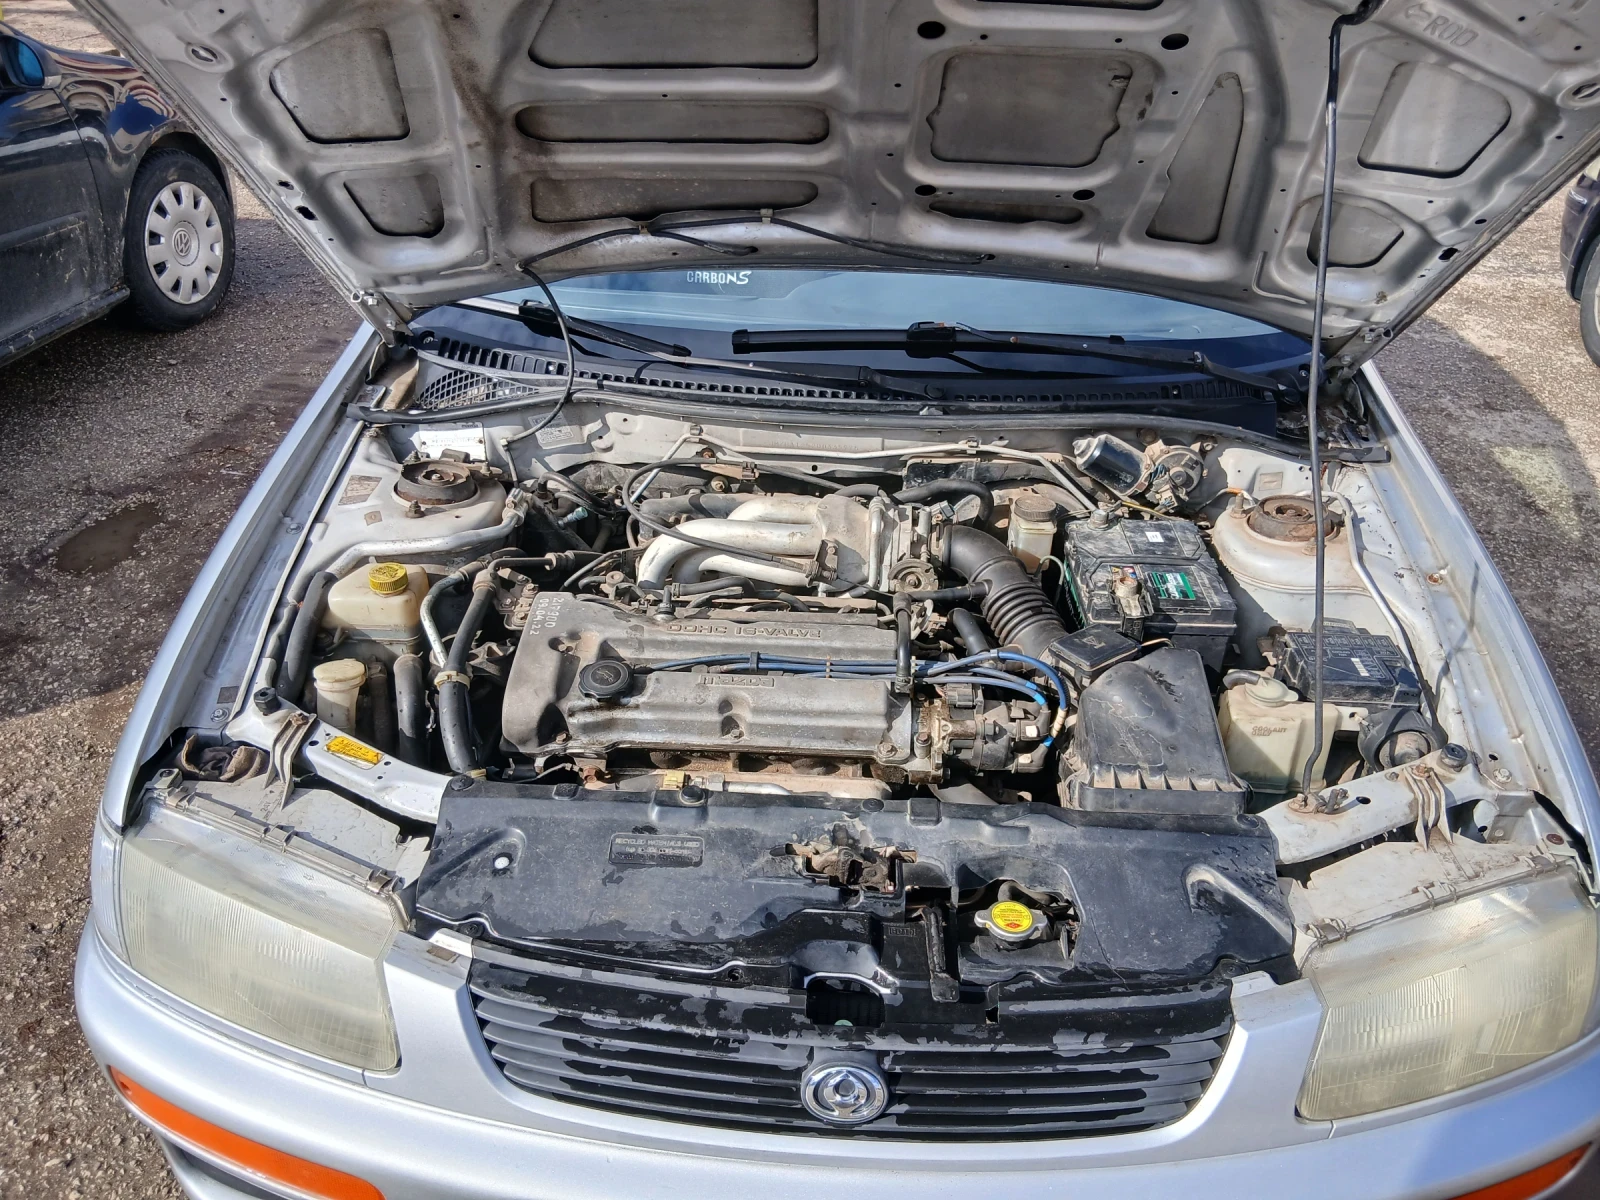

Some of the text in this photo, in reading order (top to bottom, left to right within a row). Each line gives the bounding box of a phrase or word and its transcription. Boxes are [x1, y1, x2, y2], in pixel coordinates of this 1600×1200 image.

[1423, 15, 1479, 47] ROD
[173, 228, 191, 257] VW
[687, 271, 752, 285] CARBONS
[530, 598, 549, 635] 09.04.22
[667, 624, 821, 639] DOHC 16-VALVE
